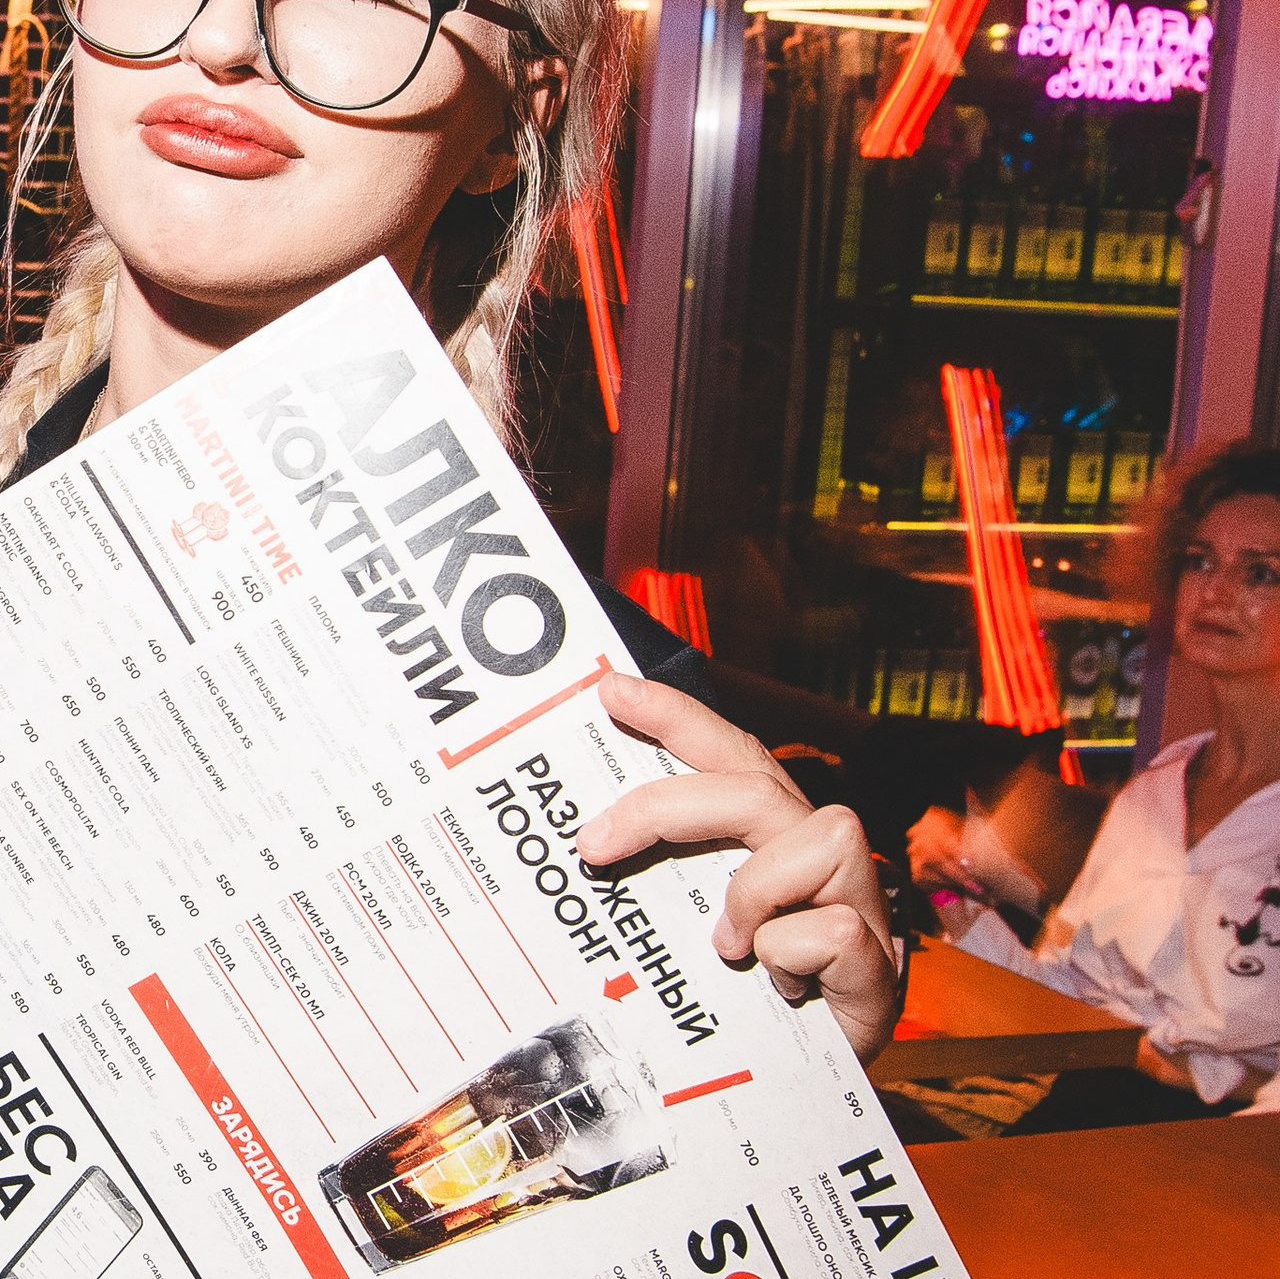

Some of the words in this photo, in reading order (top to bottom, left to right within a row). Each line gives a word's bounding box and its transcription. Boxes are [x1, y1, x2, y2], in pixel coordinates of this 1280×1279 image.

[147, 418, 179, 461] MARTINI
[172, 459, 196, 491] FIERO
[175, 396, 256, 508] MARTINI
[302, 347, 568, 678] АЛКО
[243, 384, 481, 727] КОКТЕЙЛИ
[251, 515, 303, 586] TIME
[211, 590, 235, 621] 900
[308, 595, 342, 644] ПАЛОМА
[61, 694, 81, 717] 650
[233, 641, 259, 677] WHITE
[253, 676, 287, 722] RUSSIAN
[584, 721, 626, 785] РОМ-КОЛА
[44, 759, 100, 839] COSMOPOLITAN
[335, 805, 356, 829] 450
[3, 843, 35, 885] SUNRISE
[361, 850, 387, 885] Бухаю
[420, 816, 445, 851] Плати
[439, 805, 475, 857] ТЕКИЛА
[469, 855, 487, 873] 20
[481, 873, 501, 895] МЛ
[391, 834, 424, 880] ВОДКА
[419, 879, 436, 896] 20
[431, 896, 451, 918] МЛ
[475, 777, 621, 964] ЛООООНГ
[688, 888, 710, 914] 500
[146, 914, 166, 937] 480
[209, 936, 236, 973] КОЛА
[292, 890, 325, 928] ДЖИН
[318, 928, 335, 945] 20
[330, 945, 349, 966] МЛ
[193, 946, 223, 989] Возбуди
[220, 988, 240, 1014] меня
[252, 913, 301, 983] ТРИПЛ-СЕК
[295, 982, 311, 999] 20
[306, 999, 325, 1020] МЛ
[75, 1012, 109, 1062] TROPICAL
[106, 1061, 123, 1081] GIN
[101, 998, 127, 1036] VODKA
[123, 1034, 141, 1056] RED
[137, 1055, 156, 1081] BULL
[173, 1162, 192, 1185] 550
[198, 1148, 218, 1172] 390
[211, 1095, 302, 1226] ЗАРЯДИСЬ
[739, 1139, 760, 1167] 700
[221, 1187, 255, 1230] ДЫННАЯ
[251, 1230, 268, 1252] ФЕЯ
[818, 1171, 853, 1228] ЗЕЛЕНЫЙ
[837, 1148, 915, 1253] НА
